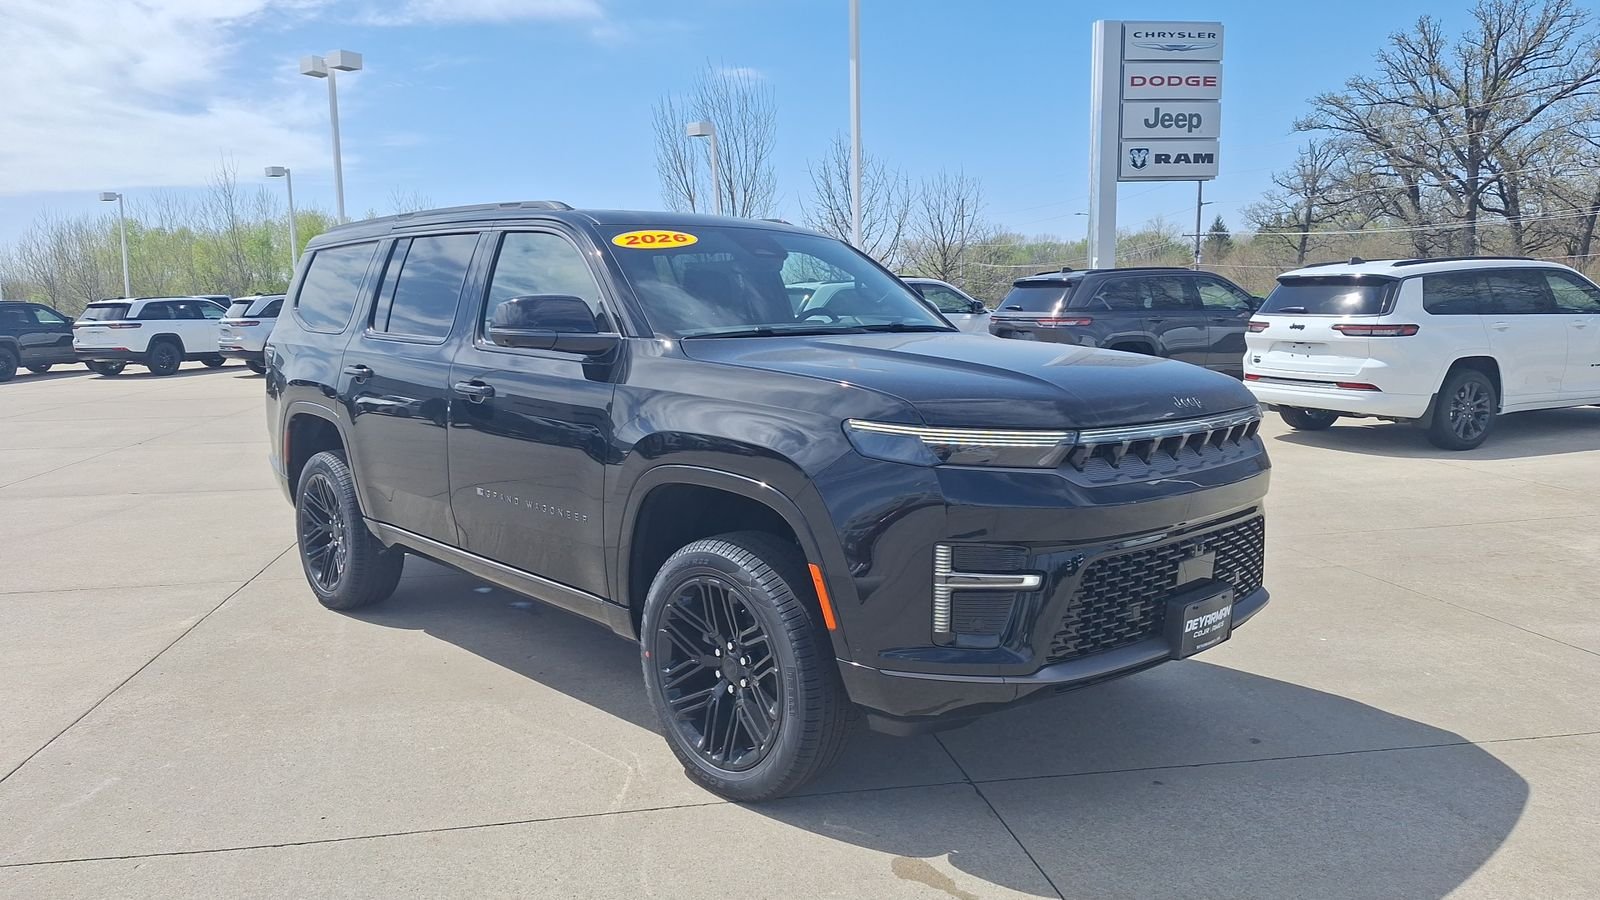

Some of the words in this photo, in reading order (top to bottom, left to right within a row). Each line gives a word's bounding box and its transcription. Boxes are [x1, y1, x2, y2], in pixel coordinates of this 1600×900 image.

[1133, 31, 1217, 39] CHRYSLER
[1130, 76, 1217, 87] DODGE
[1144, 107, 1202, 133] Jeep
[1154, 153, 1214, 164] RAM
[624, 234, 688, 245] 2026
[486, 489, 519, 505] GRAND
[526, 501, 588, 521] WAGONEER
[1184, 604, 1232, 633] DEYARMAN
